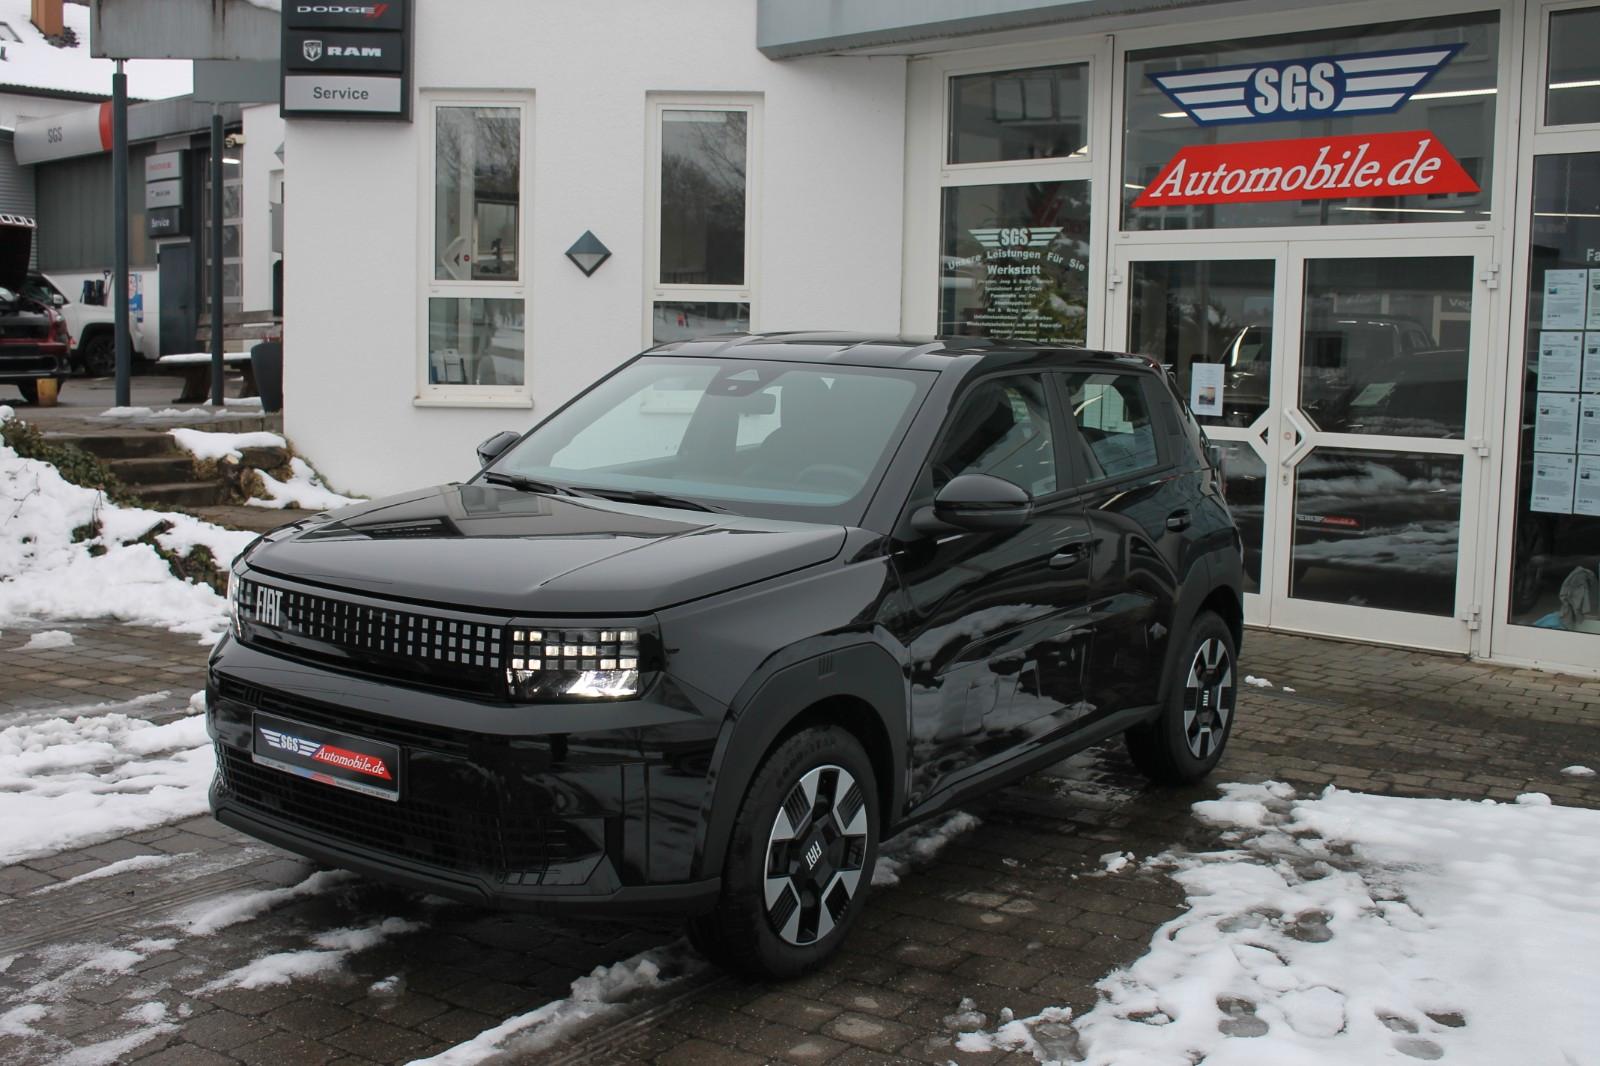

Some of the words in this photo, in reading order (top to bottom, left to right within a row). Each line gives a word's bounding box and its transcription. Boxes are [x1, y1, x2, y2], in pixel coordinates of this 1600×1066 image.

[297, 6, 376, 14] DODGE
[327, 46, 382, 57] RAM
[313, 86, 369, 100] Service
[1254, 62, 1336, 114] SGS
[47, 126, 63, 144] SGS
[1150, 138, 1442, 198] Automobile.de
[1001, 228, 1029, 246] SGS
[987, 249, 1041, 260] Leistungen
[1047, 252, 1063, 264] Für
[1069, 258, 1085, 271] Sie
[987, 265, 1041, 275] Werkstatt
[255, 585, 284, 627] FIAT
[280, 734, 298, 752] SGS
[316, 747, 385, 775] Automobile.de
[805, 840, 823, 871] FIAT
